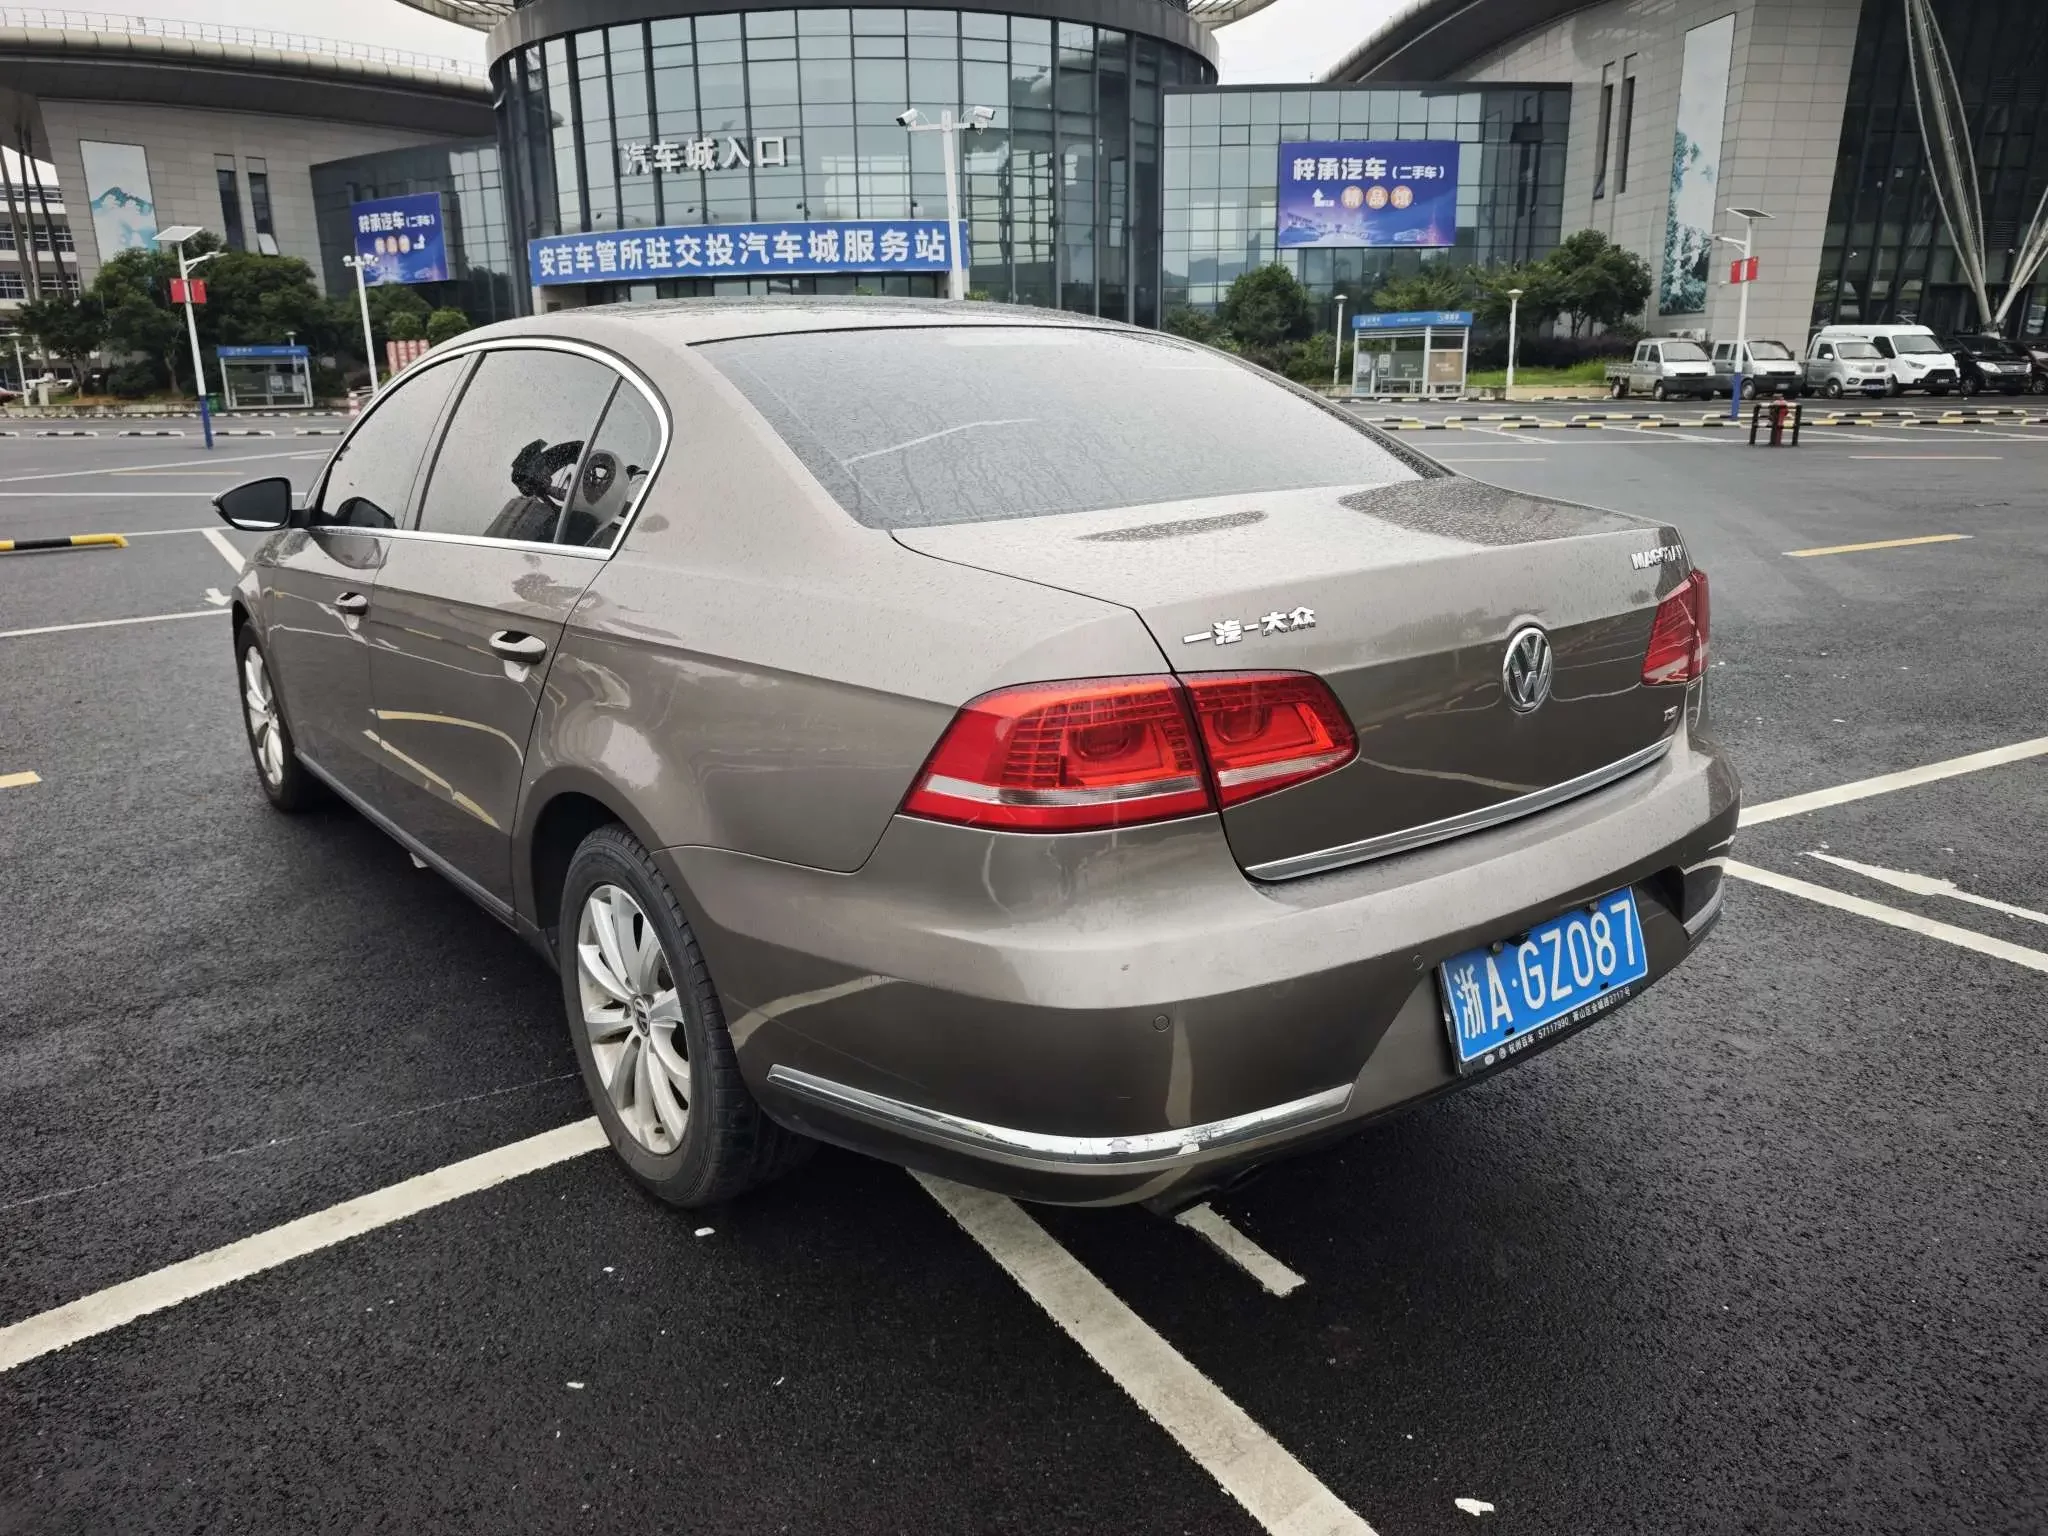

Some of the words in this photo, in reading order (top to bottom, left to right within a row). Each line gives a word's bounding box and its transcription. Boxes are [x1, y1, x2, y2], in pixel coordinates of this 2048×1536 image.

[623, 136, 788, 175] 汽车城入口
[539, 228, 946, 277] 安吉车管所驻交投汽车城服务站
